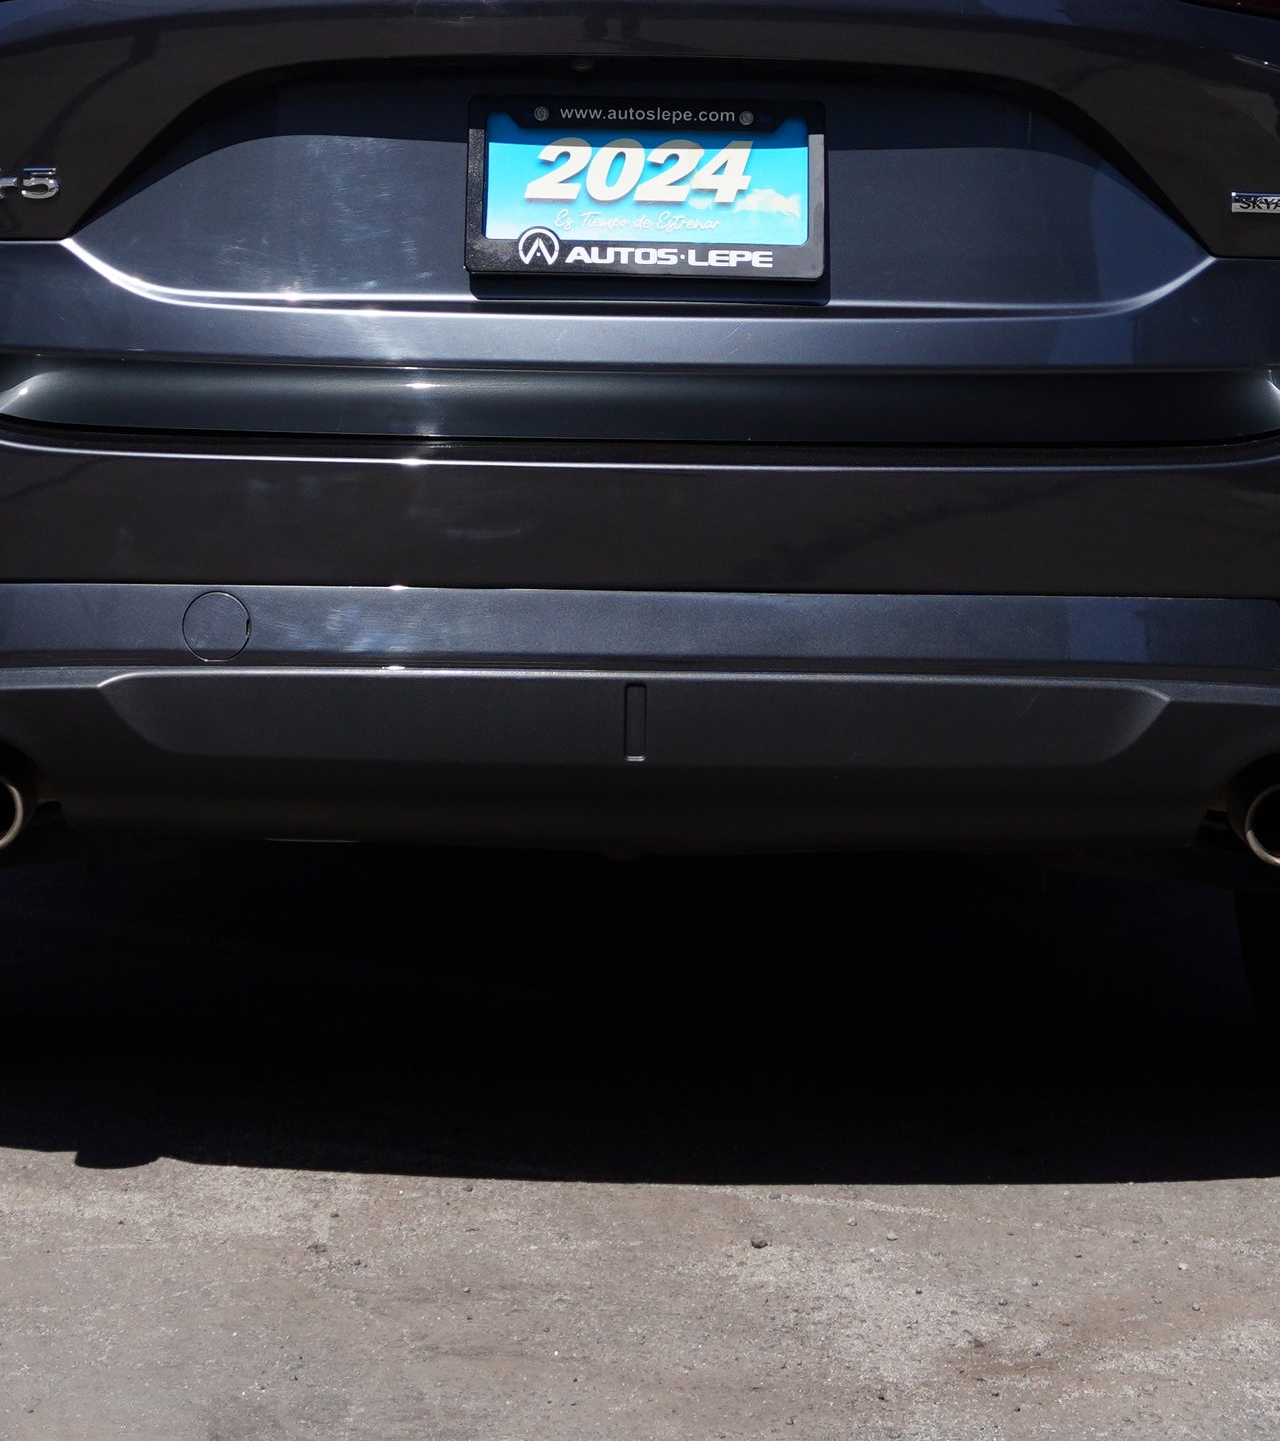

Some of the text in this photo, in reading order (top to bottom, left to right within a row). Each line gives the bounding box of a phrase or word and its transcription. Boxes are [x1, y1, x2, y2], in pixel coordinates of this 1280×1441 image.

[559, 106, 736, 123] www.autoslepe.com
[523, 135, 754, 203] 2024
[553, 208, 721, 233] Es Tiempo de Estrenar
